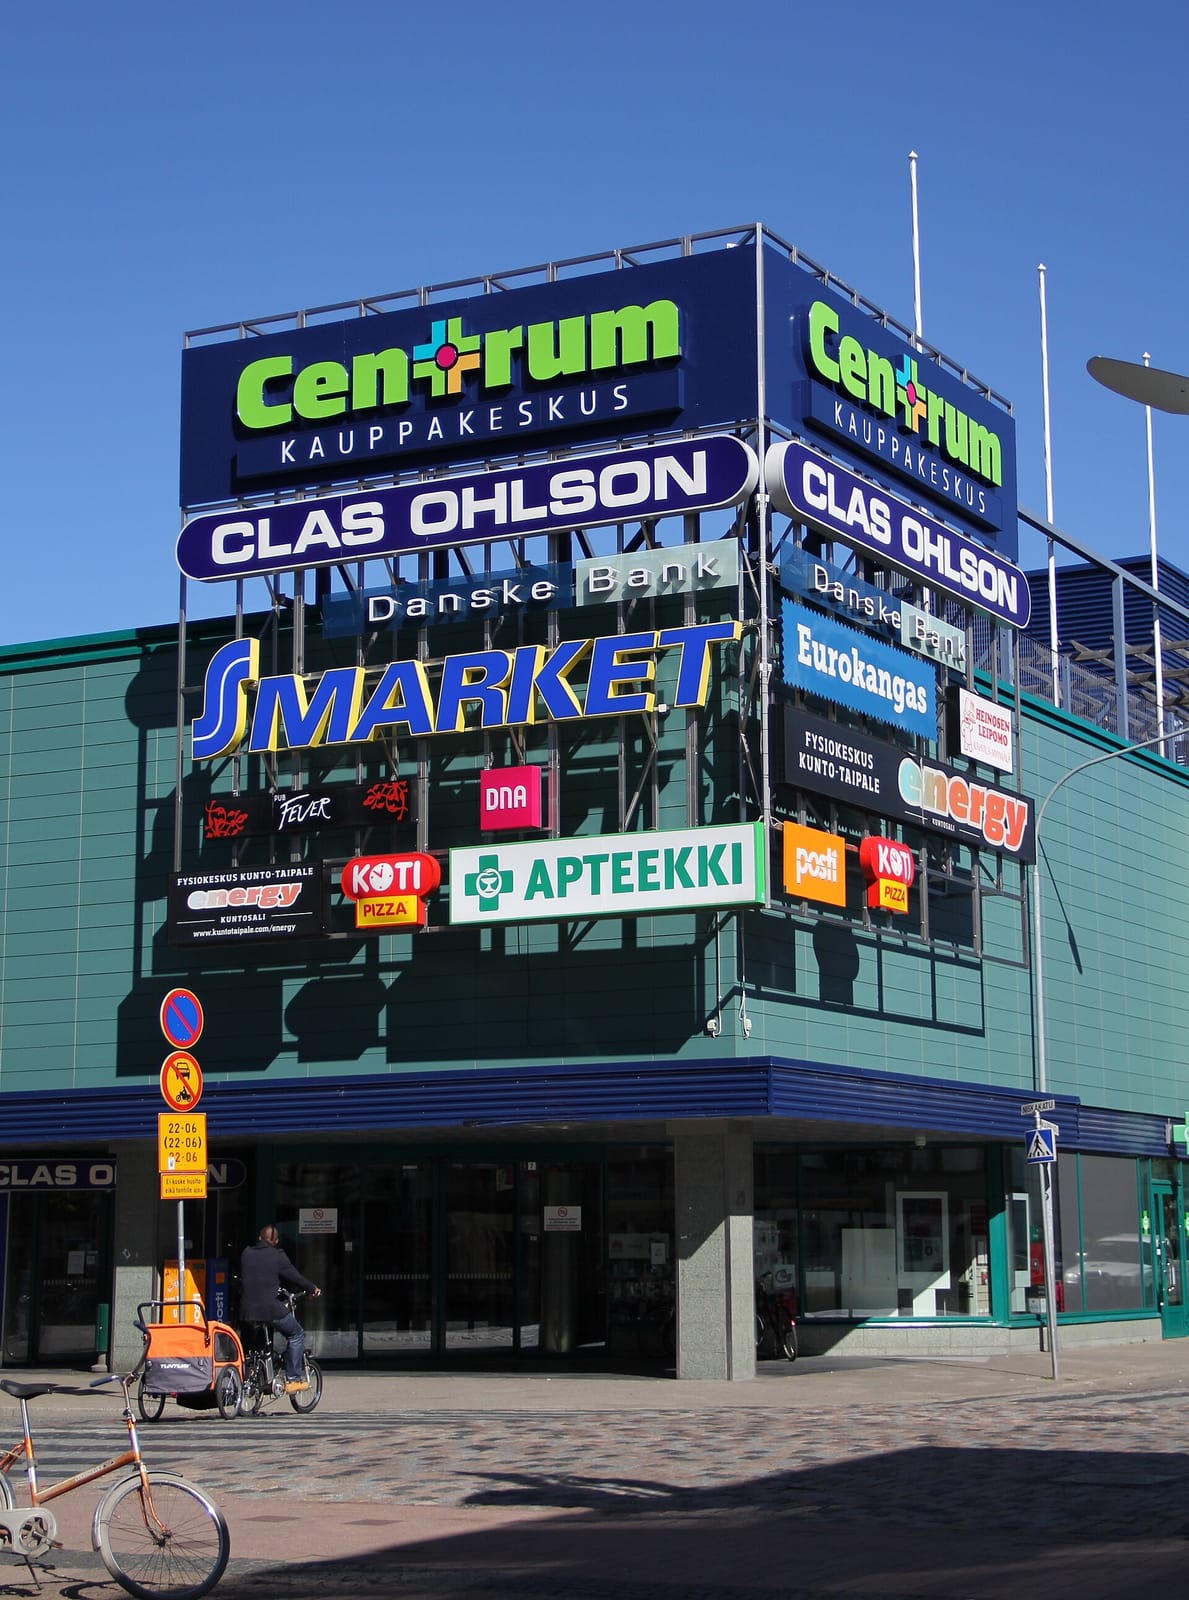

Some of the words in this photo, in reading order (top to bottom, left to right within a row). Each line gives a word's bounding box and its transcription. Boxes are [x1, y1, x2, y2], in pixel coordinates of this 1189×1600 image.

[236, 299, 680, 430] Centrum
[809, 301, 1002, 487] Centrum
[281, 384, 628, 464] KAUPPAKESKUS
[834, 400, 985, 513] KAUPPAKESKUS
[211, 501, 385, 565] CLAS
[410, 450, 707, 536] OHLSON
[802, 460, 892, 545] CLAS
[901, 515, 1018, 614] OHLSON
[368, 578, 557, 622] Danske
[587, 551, 722, 594] Bank
[814, 563, 902, 630] Danske
[914, 614, 967, 662] Bank
[796, 623, 928, 714] Eurokangas
[976, 707, 1011, 732] HEINOSEN
[978, 724, 1009, 747] LEIPOMO
[805, 730, 874, 770] FYSIOKESKUS
[798, 751, 880, 794] KUNTO-TAIPALE
[273, 793, 287, 802] PUB
[277, 793, 332, 831] FEVER
[486, 785, 527, 811] DNA
[898, 756, 1029, 851] energy
[177, 873, 238, 886] FYSIOKESKUS
[240, 867, 314, 881] KUNTO-TAIPALE
[353, 860, 421, 894] KOTI
[524, 842, 744, 901] APTEEKKI
[796, 847, 838, 884] posti
[878, 843, 911, 881] KOTI
[187, 882, 303, 910] energy
[363, 901, 408, 918] PIZZA
[192, 924, 297, 937] www.kuntotaipale.com/energy
[220, 913, 266, 923] KUNTOSALI
[168, 1123, 197, 1134] 22-06
